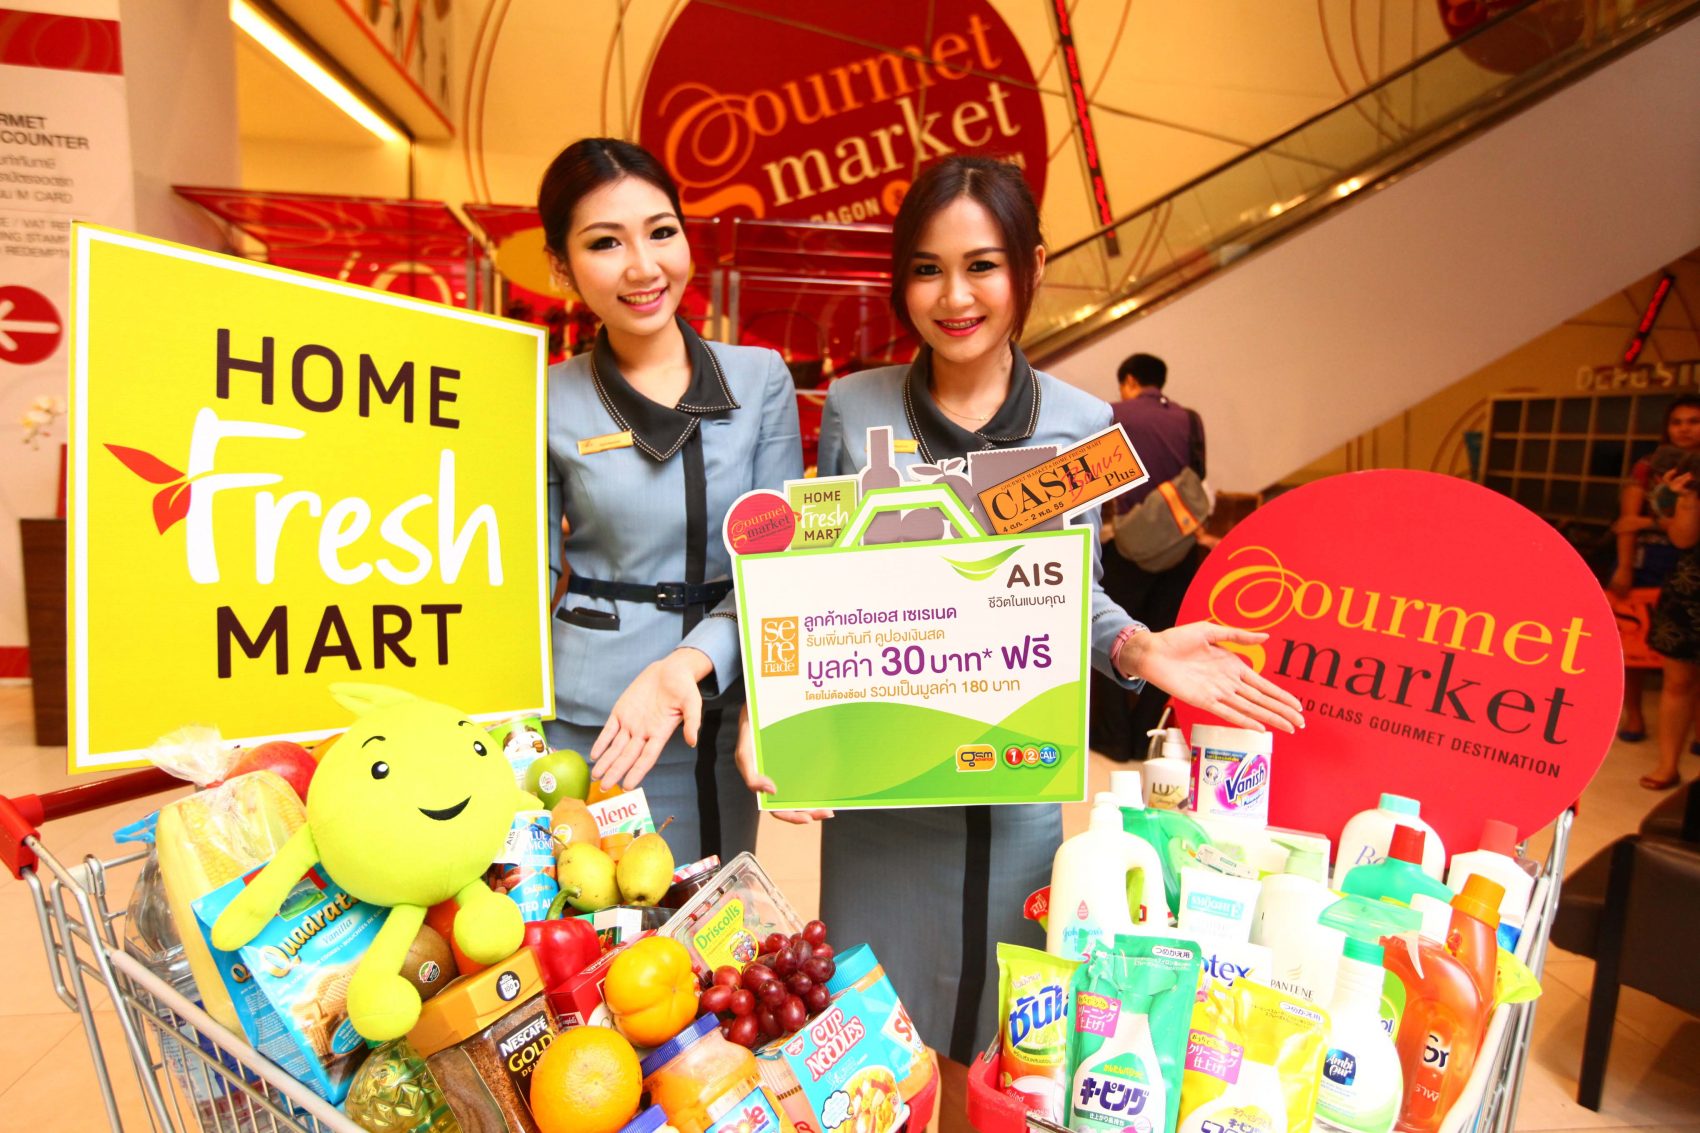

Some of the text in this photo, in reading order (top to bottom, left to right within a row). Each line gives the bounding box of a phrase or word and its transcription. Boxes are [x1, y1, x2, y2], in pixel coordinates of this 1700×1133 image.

[657, 14, 1003, 219] Gourmet
[1, 130, 89, 149] COUNTER
[762, 82, 1022, 208] market
[216, 328, 461, 429] HOME
[992, 453, 1101, 521] CASH
[1061, 445, 1123, 503] Bonus
[1104, 468, 1136, 487] Plus
[186, 406, 504, 587] Fresh
[804, 490, 841, 504] HOME
[747, 515, 791, 538] market
[800, 503, 849, 530] Fresh
[804, 527, 843, 542] MART
[1006, 562, 1064, 589] AIS
[988, 594, 1066, 609] ชีวิตในแบบคุณ
[1209, 546, 1592, 676] Gourmet
[764, 619, 796, 643] se
[804, 606, 958, 633] ลูกค้าเอไอเอส เซเรเนด
[217, 604, 463, 679] MART
[764, 641, 796, 664] re
[806, 628, 946, 648] รับเพิ่มทันที คูปองเงินสด
[764, 657, 796, 673] nade
[807, 650, 873, 689] มูลค่า
[881, 645, 925, 677] 30
[1001, 633, 1052, 670] ฟรี
[870, 679, 957, 700] รวมเป็นมูลค่า
[962, 679, 988, 693] 180
[992, 679, 1021, 692] บาท
[1273, 637, 1575, 745] market
[1319, 702, 1363, 725] CLASS
[1369, 715, 1446, 747] GOURMET
[1450, 737, 1561, 778] DESTINATION
[1152, 782, 1181, 797] LUX
[1226, 763, 1266, 801] Vanish
[262, 892, 355, 979] Quadrat
[322, 918, 353, 946] Vanilla
[1201, 954, 1250, 987] otex
[1270, 979, 1316, 999] PANTENE
[500, 1015, 548, 1057] NESCAFÉ
[811, 1008, 844, 1047] CUP
[508, 1034, 553, 1072] GOLD
[805, 1016, 866, 1082] NOODLES
[1326, 1053, 1354, 1070] Ambi
[1080, 1077, 1150, 1116] キーピング
